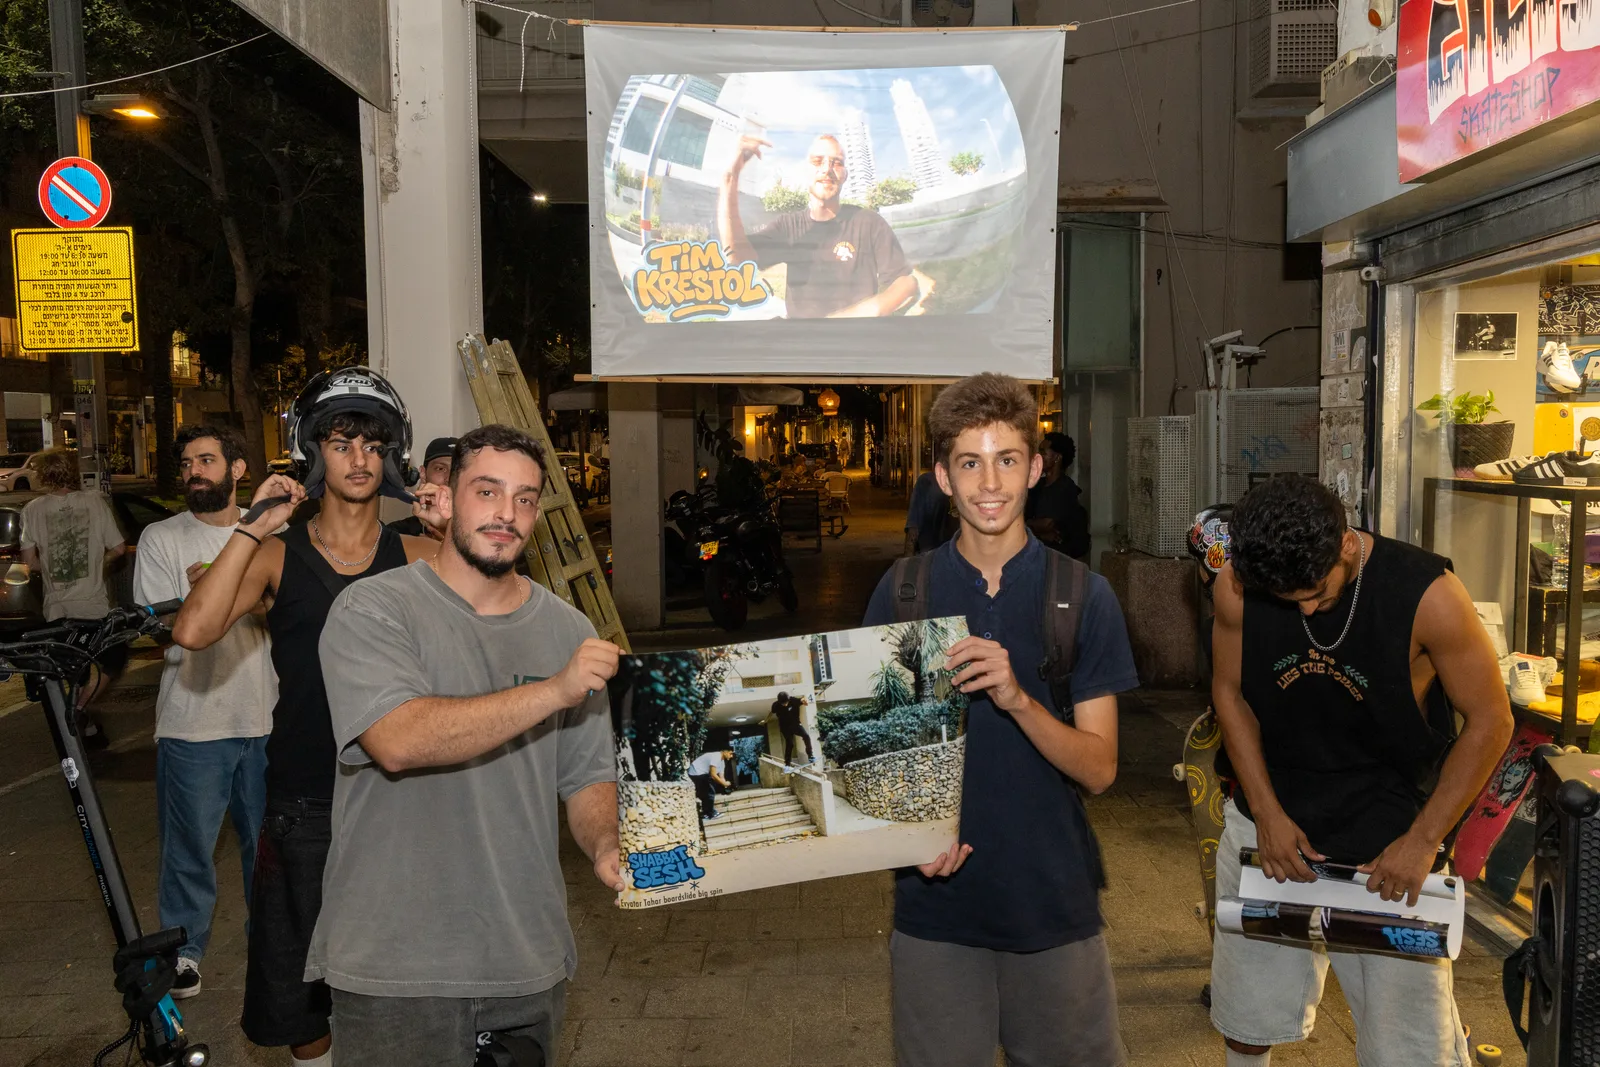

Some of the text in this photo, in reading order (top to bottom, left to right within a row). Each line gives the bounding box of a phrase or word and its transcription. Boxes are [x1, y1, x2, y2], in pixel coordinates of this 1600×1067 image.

[1458, 67, 1561, 143] SKATESHOP
[636, 263, 768, 310] KRESTOL
[333, 377, 369, 386] Arai
[1276, 662, 1364, 701] LIES THE POWER
[628, 845, 688, 870] SHABBAT
[633, 858, 705, 889] SESH
[98, 874, 112, 908] PHOENIX
[621, 888, 723, 908] Evyatar Tahar boardslide big spin
[1382, 926, 1439, 948] SESH
